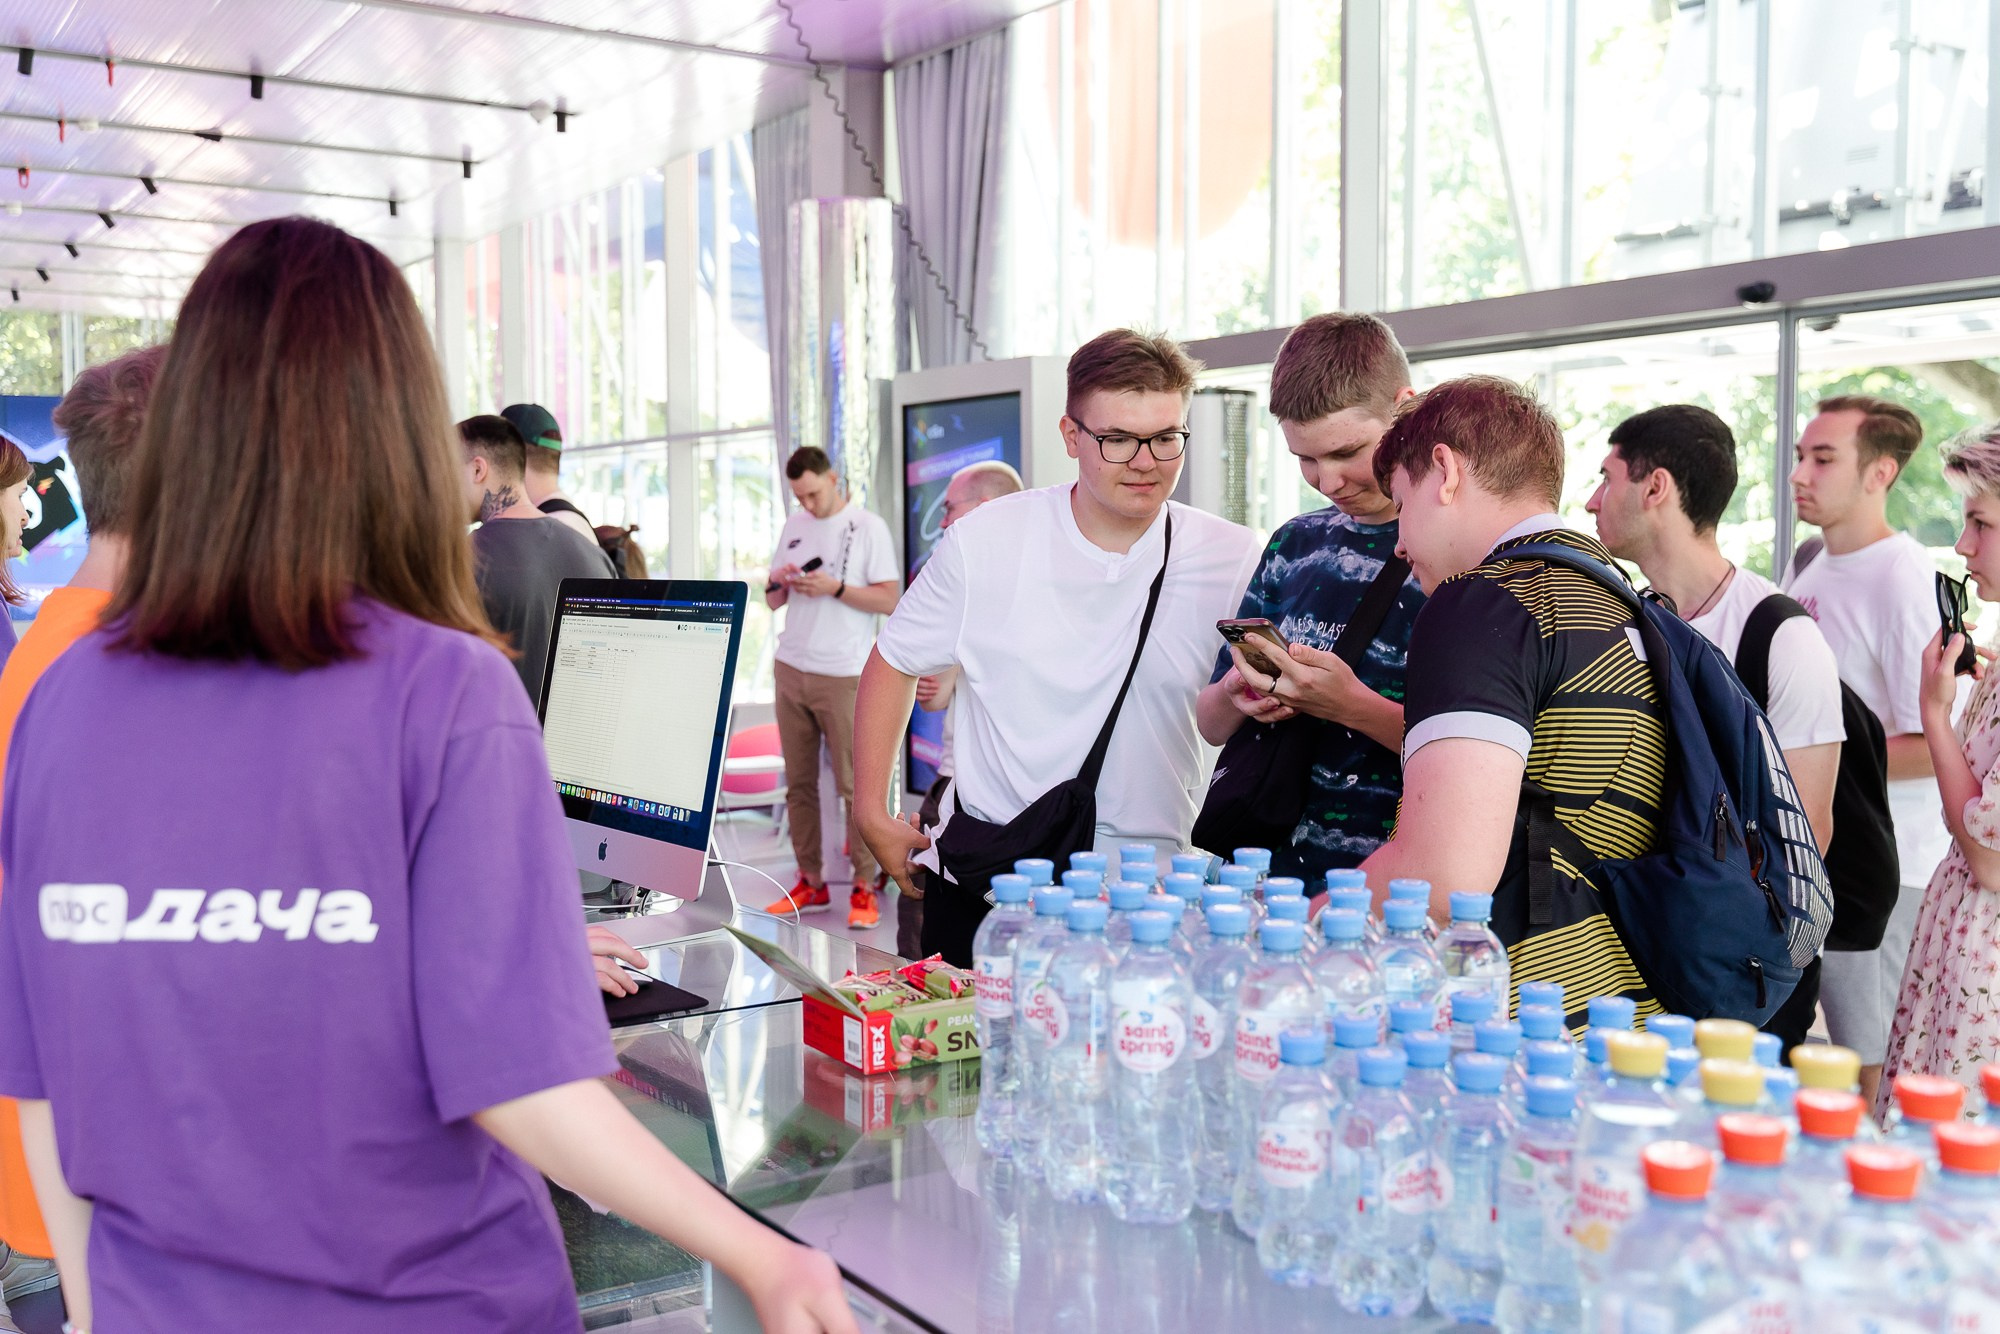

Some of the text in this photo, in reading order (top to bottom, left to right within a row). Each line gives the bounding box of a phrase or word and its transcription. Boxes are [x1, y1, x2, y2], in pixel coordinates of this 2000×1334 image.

[1292, 616, 1313, 633] LESS
[1123, 1024, 1169, 1039] saint
[869, 1024, 886, 1066] REX
[1120, 1039, 1175, 1058] spring
